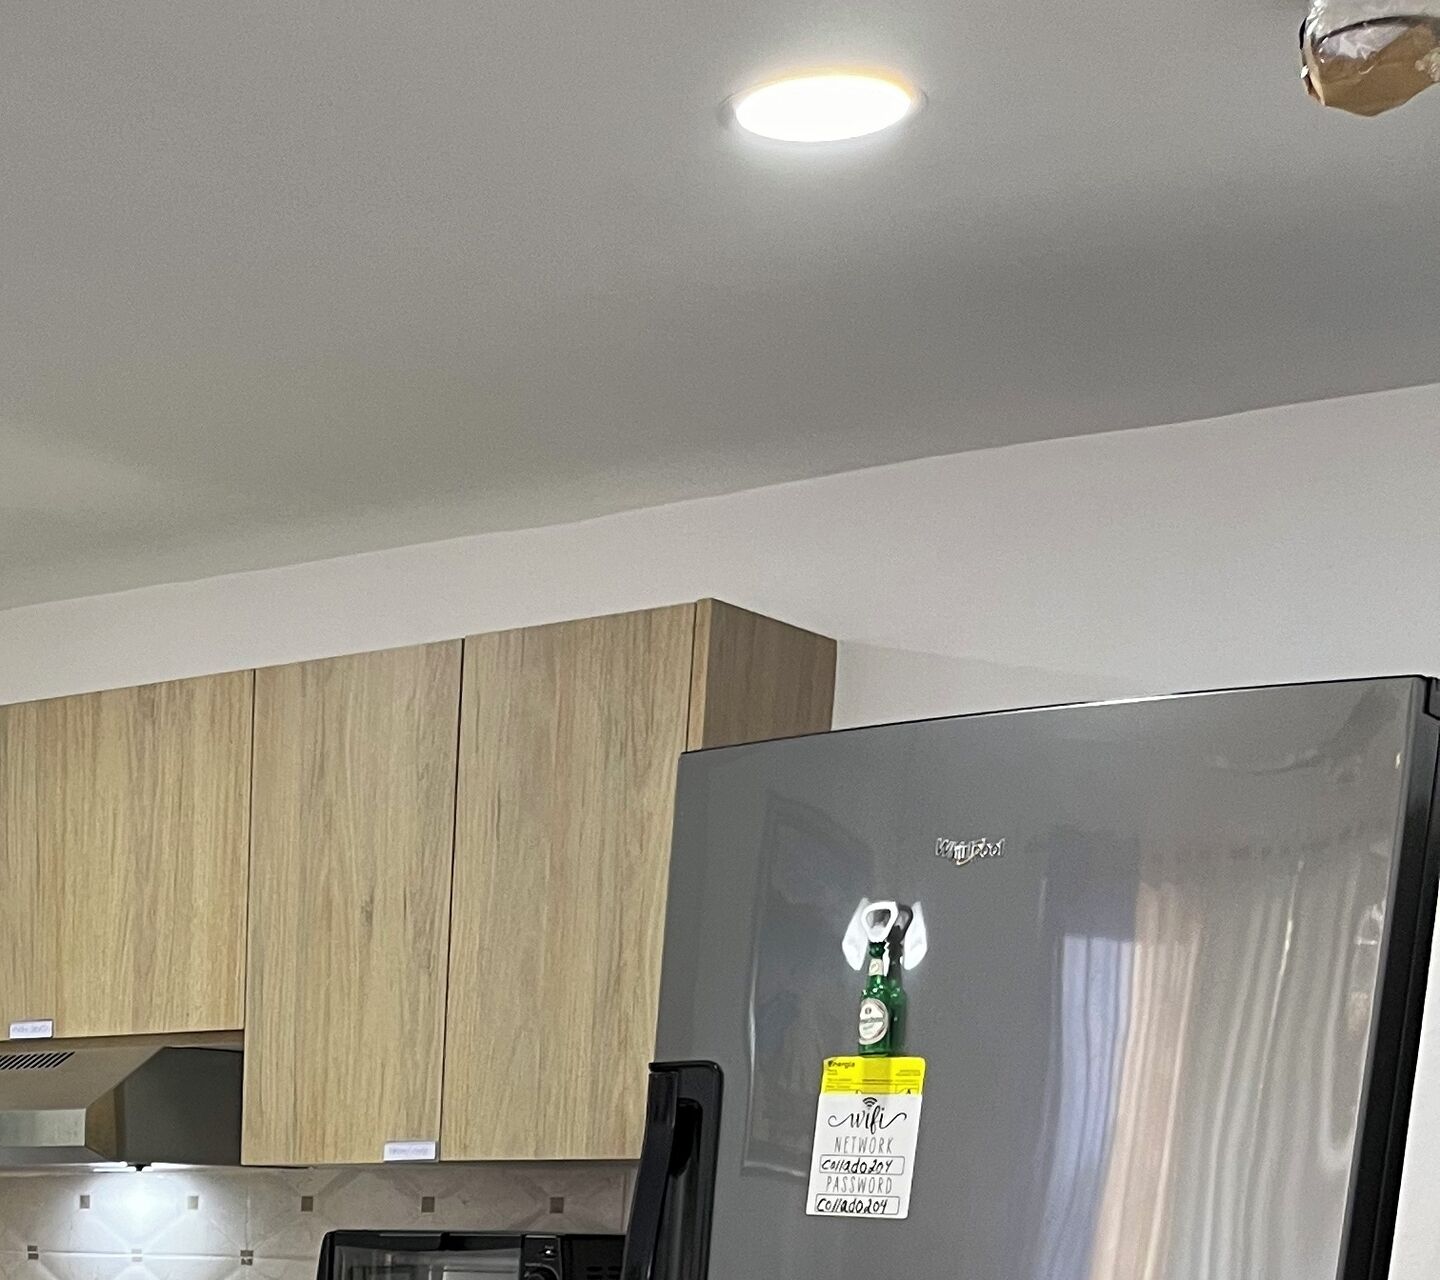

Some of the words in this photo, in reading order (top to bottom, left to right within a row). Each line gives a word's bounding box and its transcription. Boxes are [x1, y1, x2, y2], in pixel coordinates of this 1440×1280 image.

[828, 1105, 907, 1135] wifi
[834, 1136, 894, 1154] NETWORK
[826, 1175, 892, 1194] PASSWORD
